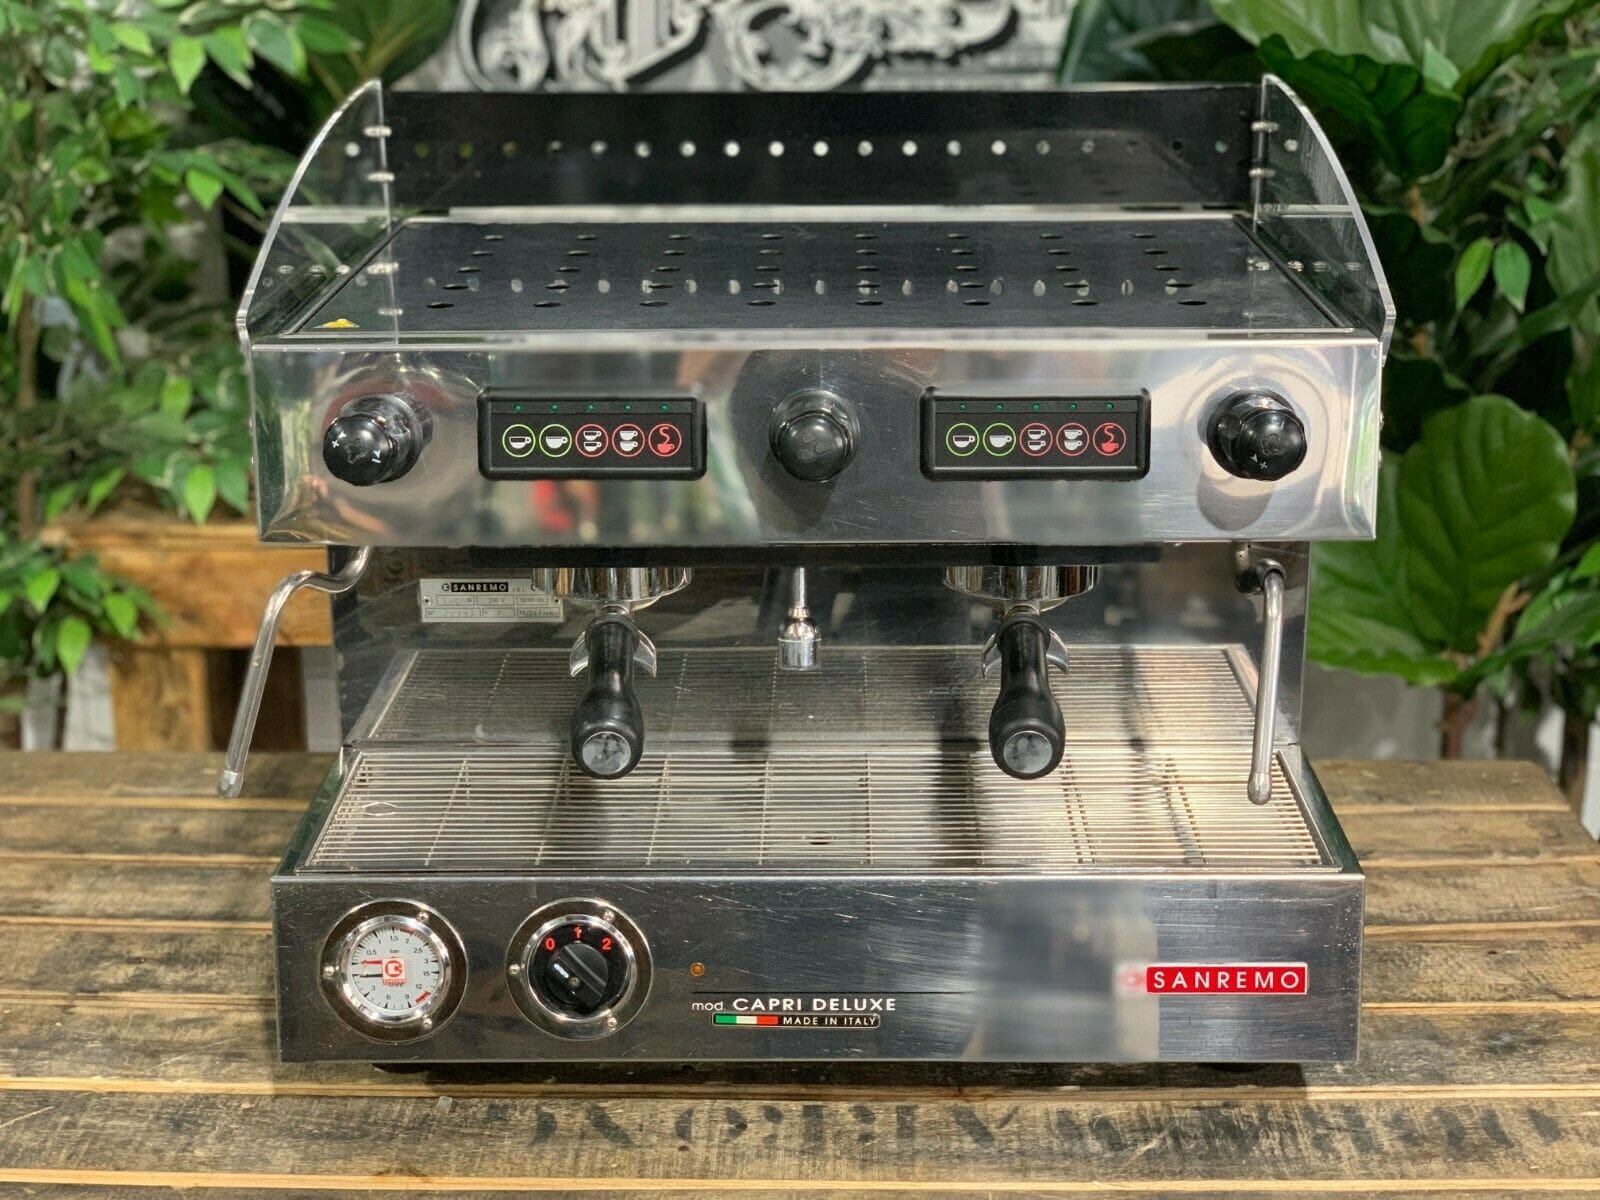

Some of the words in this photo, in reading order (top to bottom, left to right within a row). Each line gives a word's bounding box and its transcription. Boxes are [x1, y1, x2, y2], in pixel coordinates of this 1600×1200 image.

[453, 583, 507, 591] SANREMO
[545, 937, 556, 951] 0
[573, 926, 582, 939] 1
[602, 937, 612, 950] 2
[1153, 971, 1300, 989] SANREMO
[691, 1001, 727, 1012] mod.
[732, 998, 803, 1012] CAPRI
[812, 998, 897, 1012] DELUXE
[782, 1016, 819, 1026] MADE
[824, 1016, 838, 1026] IN
[844, 1015, 877, 1026] ITALY
